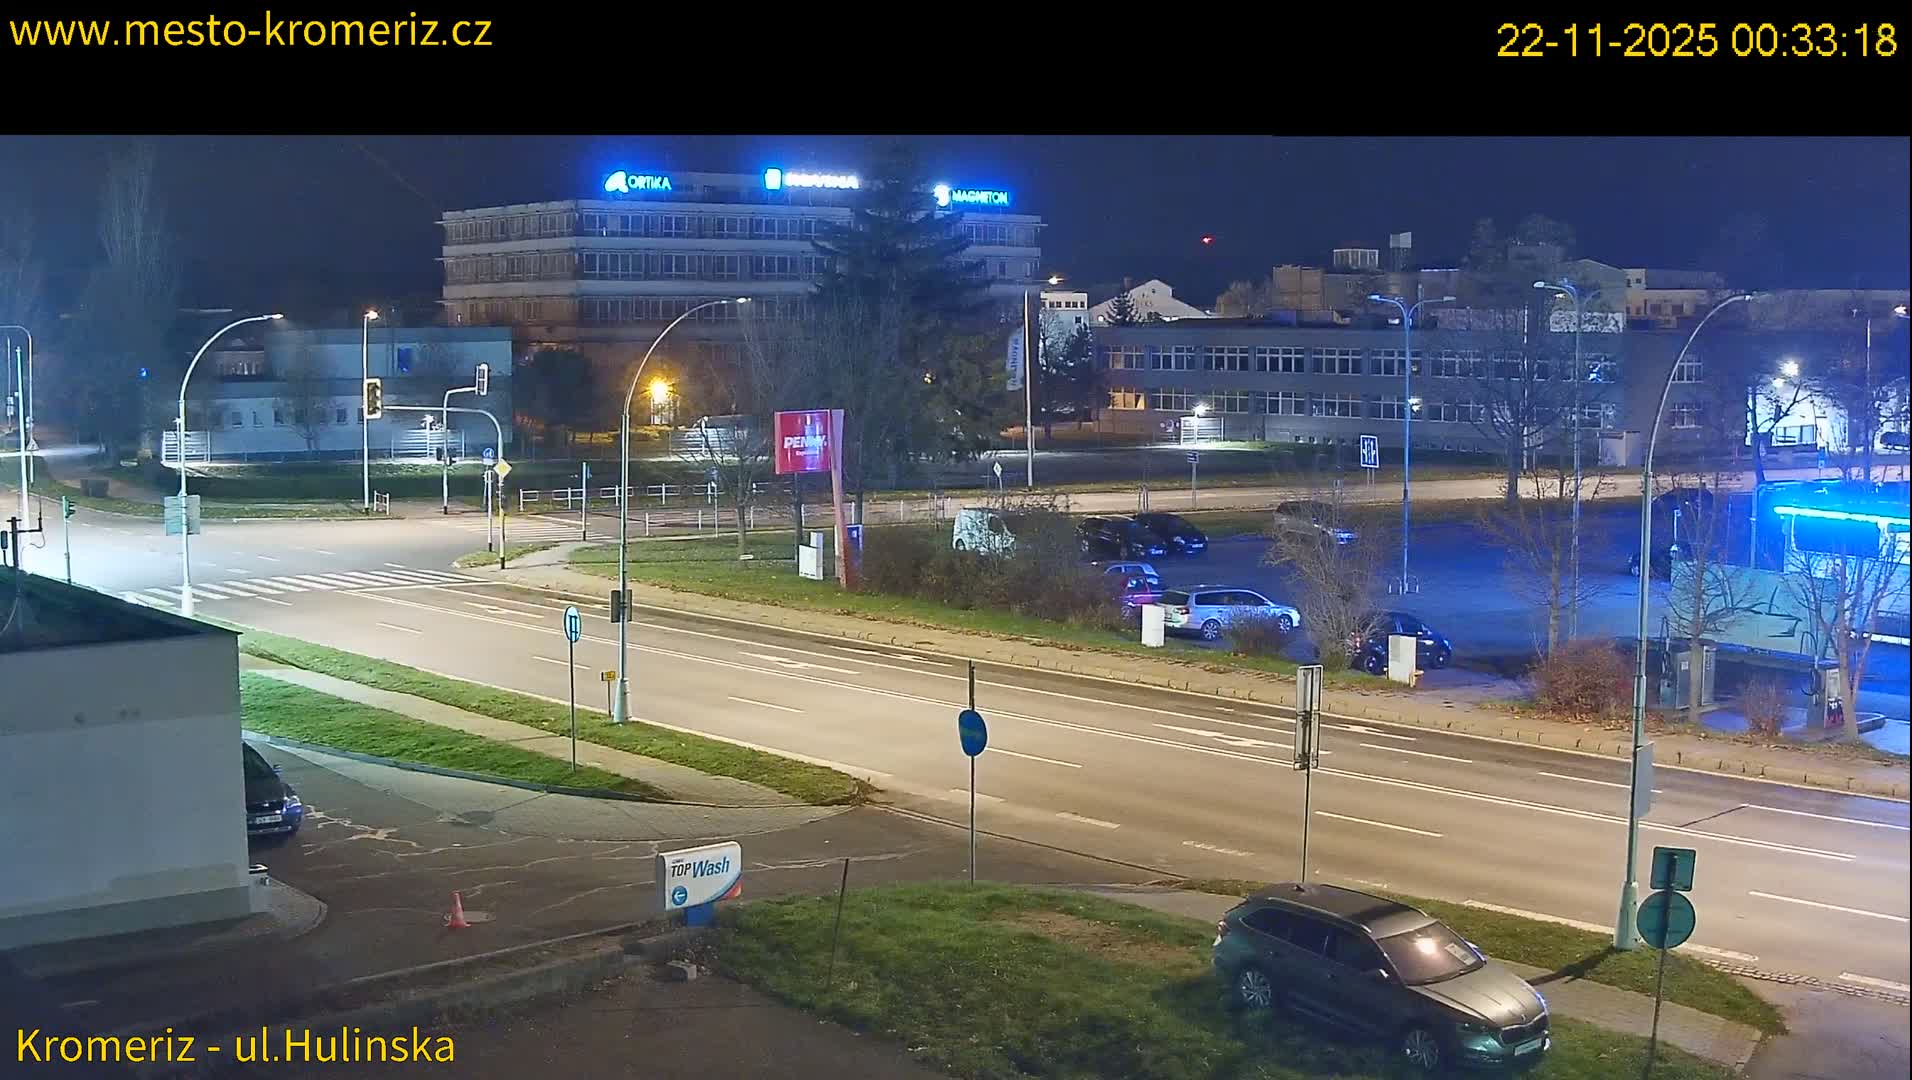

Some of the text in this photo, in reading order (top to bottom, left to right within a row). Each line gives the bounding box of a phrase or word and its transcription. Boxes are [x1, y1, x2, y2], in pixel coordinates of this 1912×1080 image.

[627, 174, 672, 190] ORTIKA
[671, 856, 730, 878] TOP Wash
